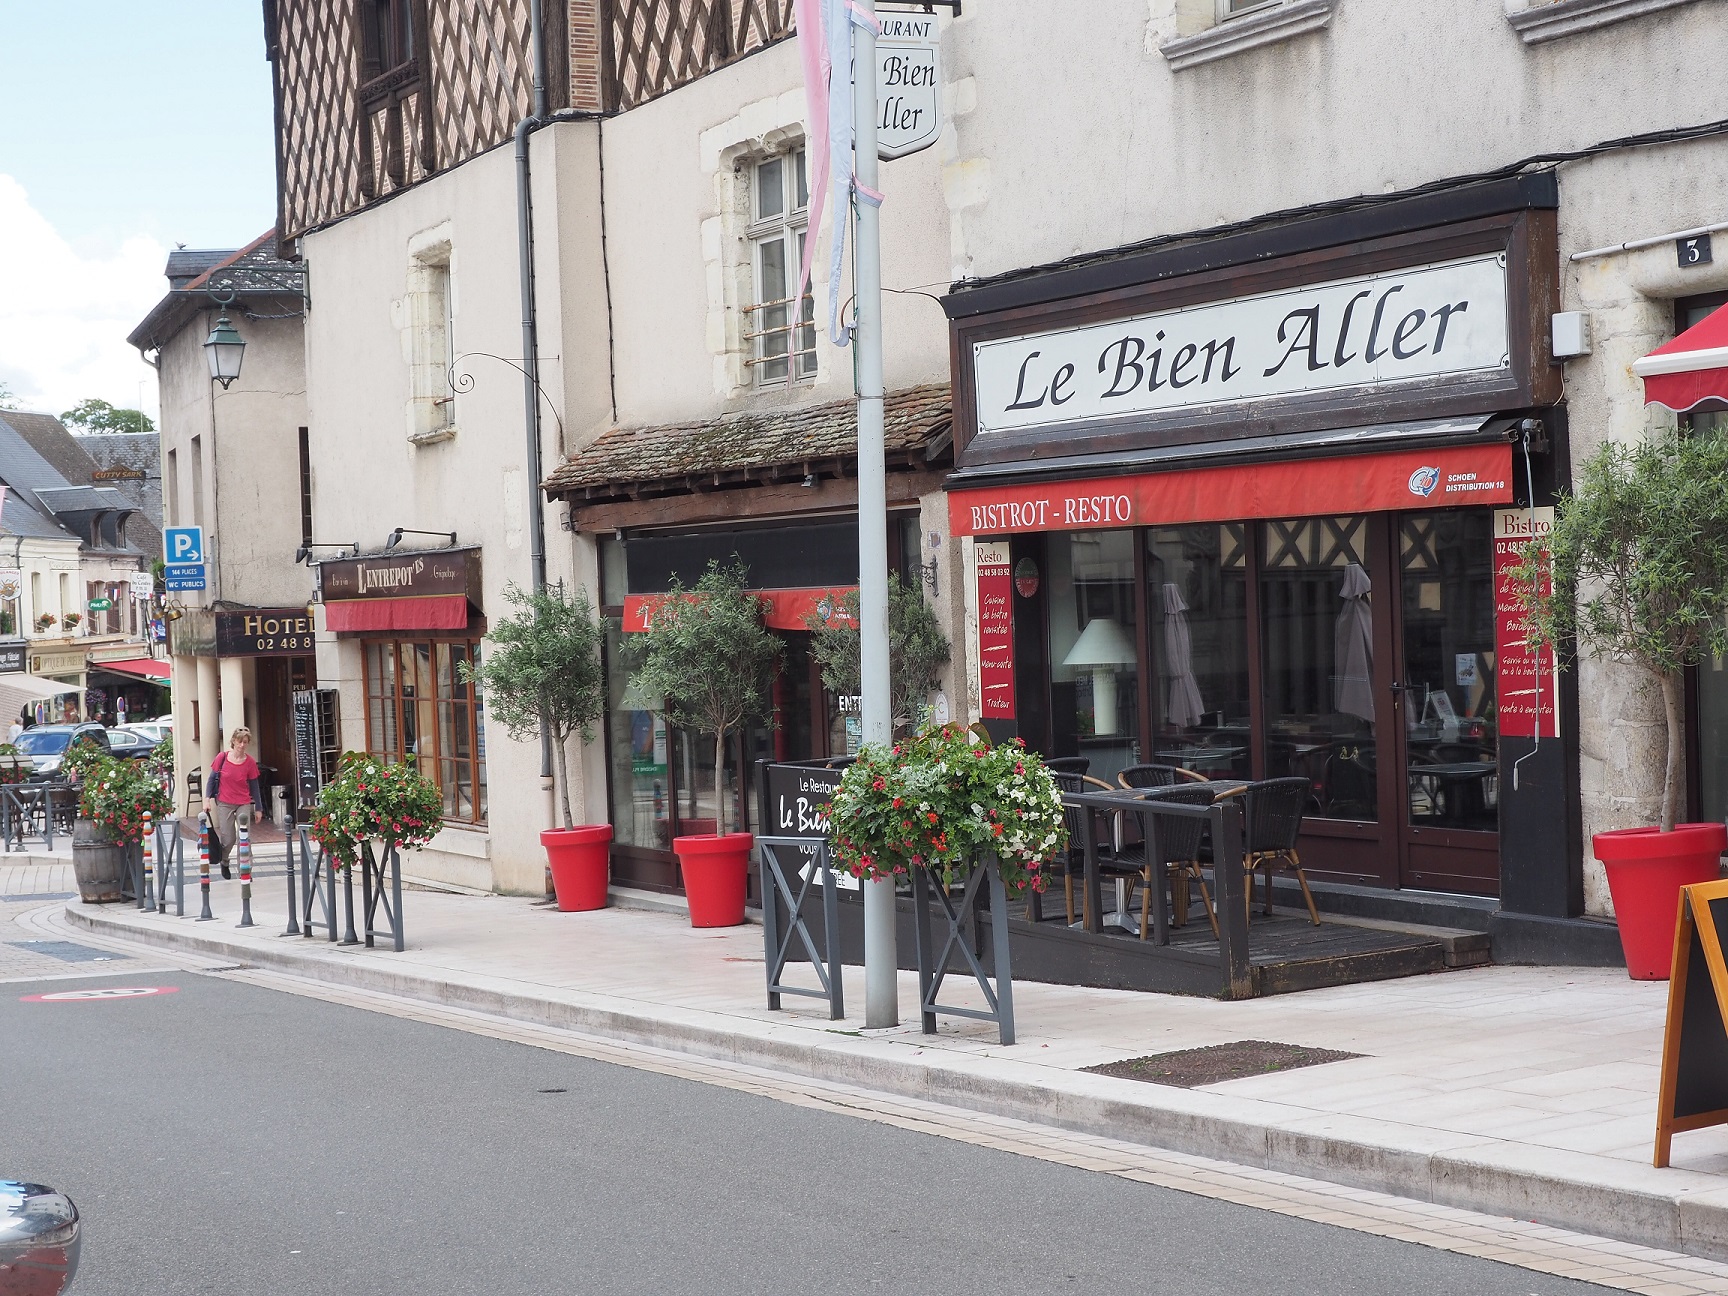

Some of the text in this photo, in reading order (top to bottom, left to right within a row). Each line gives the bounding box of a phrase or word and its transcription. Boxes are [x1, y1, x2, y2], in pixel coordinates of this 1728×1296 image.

[880, 20, 931, 37] URANT
[884, 56, 936, 87] Bien
[877, 97, 922, 130] ller
[1686, 239, 1700, 262] 3
[1003, 284, 1469, 413] Le Bien Aller
[95, 471, 121, 479] CUTTY
[1447, 472, 1477, 482] SCHOEN
[1445, 481, 1505, 492] DISTRIBUTION 18
[970, 499, 1050, 530] BISTROT
[1064, 495, 1132, 524] RESTO
[1503, 514, 1550, 535] Bistro
[174, 534, 192, 558] P
[1496, 542, 1506, 554] 02
[1507, 542, 1517, 554] 48
[977, 547, 1002, 563] Resto
[181, 568, 198, 576] PLACES
[978, 568, 1010, 577] 02 48 58 03 92
[983, 593, 1006, 605] Cuisine
[982, 606, 1008, 620] de bistro
[244, 615, 315, 636] HOTEL
[257, 638, 274, 650] 02
[280, 637, 297, 649] 48
[981, 655, 1012, 668] Menu-carte
[1515, 666, 1521, 675] la
[1523, 665, 1548, 676] boutille
[986, 695, 1010, 709] Traiteur
[1524, 702, 1552, 718] emprter
[799, 777, 809, 792] Le
[796, 796, 832, 835] Bien
